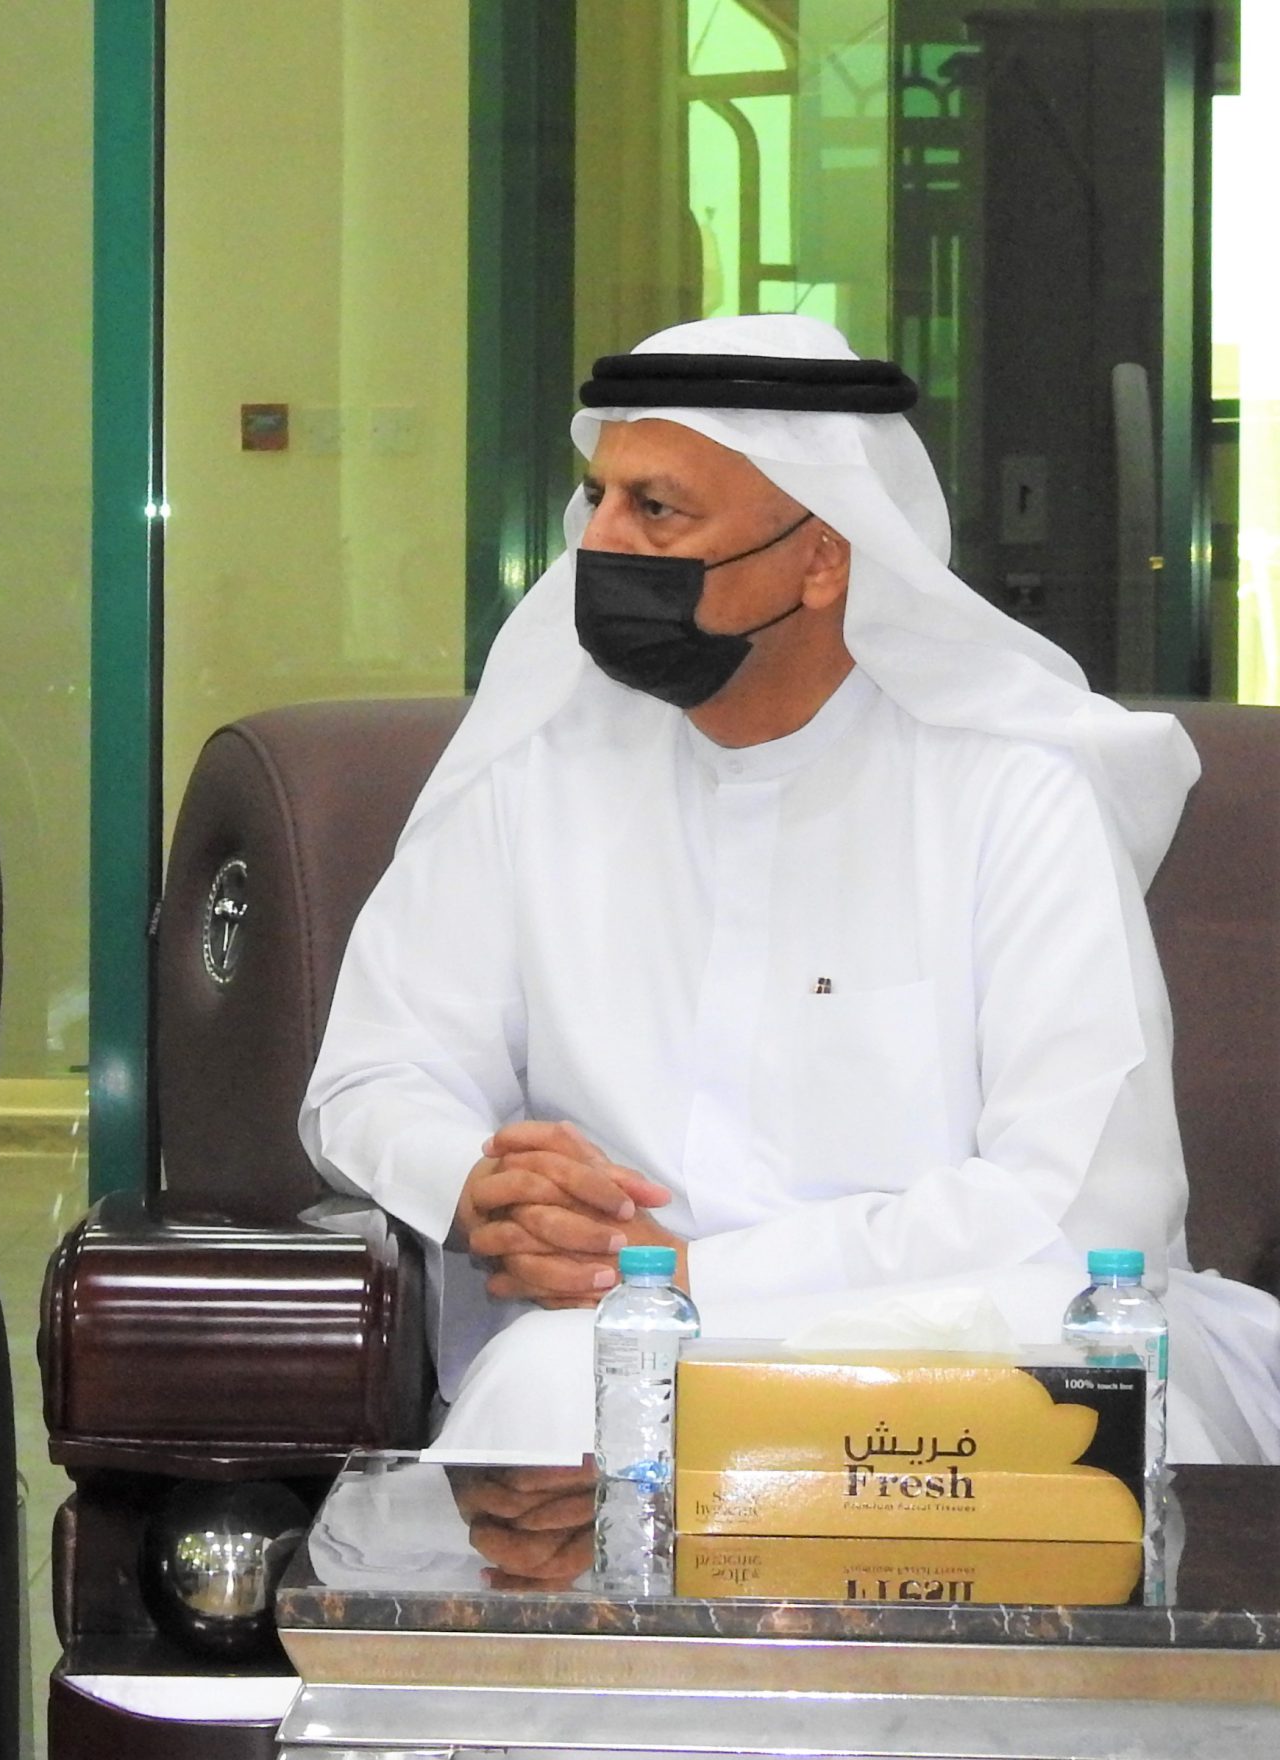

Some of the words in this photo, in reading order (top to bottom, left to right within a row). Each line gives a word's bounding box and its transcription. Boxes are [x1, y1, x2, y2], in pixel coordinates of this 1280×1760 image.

[1064, 1379, 1095, 1390] 100%
[844, 1420, 977, 1466] فريش
[843, 1463, 976, 1499] Fresh
